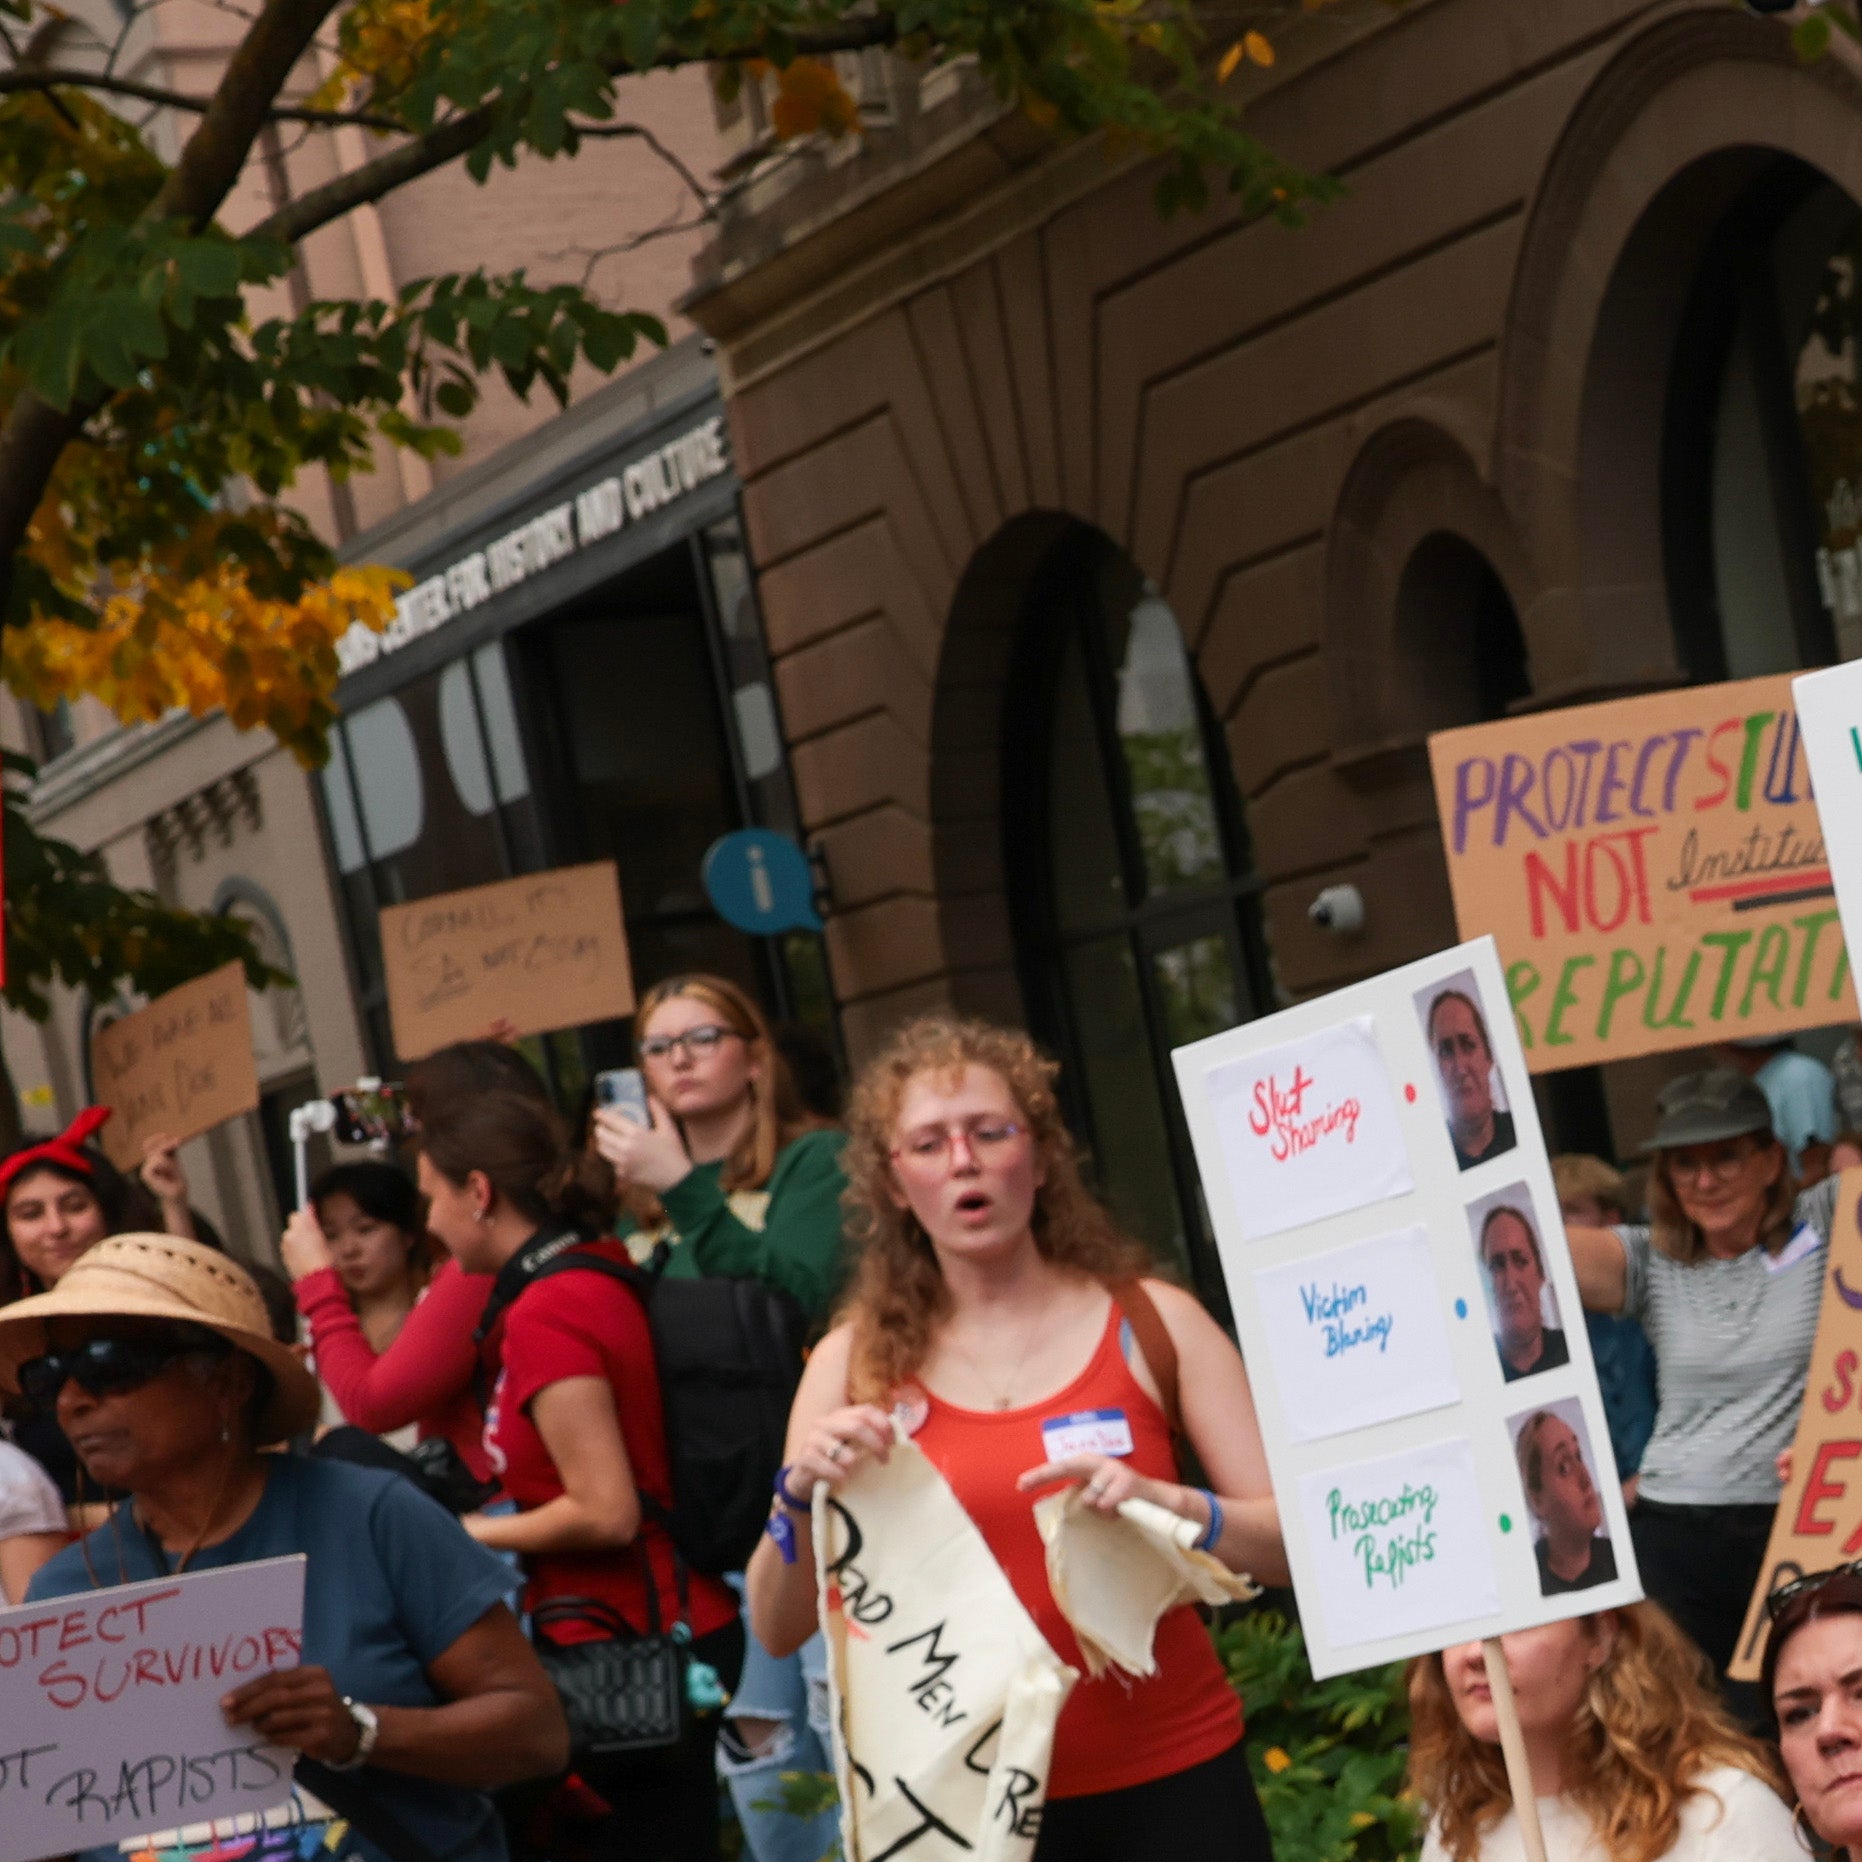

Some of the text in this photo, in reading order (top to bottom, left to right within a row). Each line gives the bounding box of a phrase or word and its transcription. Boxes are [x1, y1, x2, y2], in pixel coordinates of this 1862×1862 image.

[381, 573, 461, 655] ENTER
[622, 415, 728, 520] CULTURE
[1452, 710, 1815, 855] PROTECT STU
[1523, 826, 1659, 938] NOT
[1250, 1065, 1313, 1135] Slut
[1271, 1097, 1361, 1162] Shaming
[1300, 1281, 1368, 1328] Victim
[1323, 1313, 1393, 1358] Blaming
[1326, 1483, 1438, 1541] Prosecuting
[886, 1619, 967, 1728] MEN
[46, 1744, 281, 1823] RAPISTS
